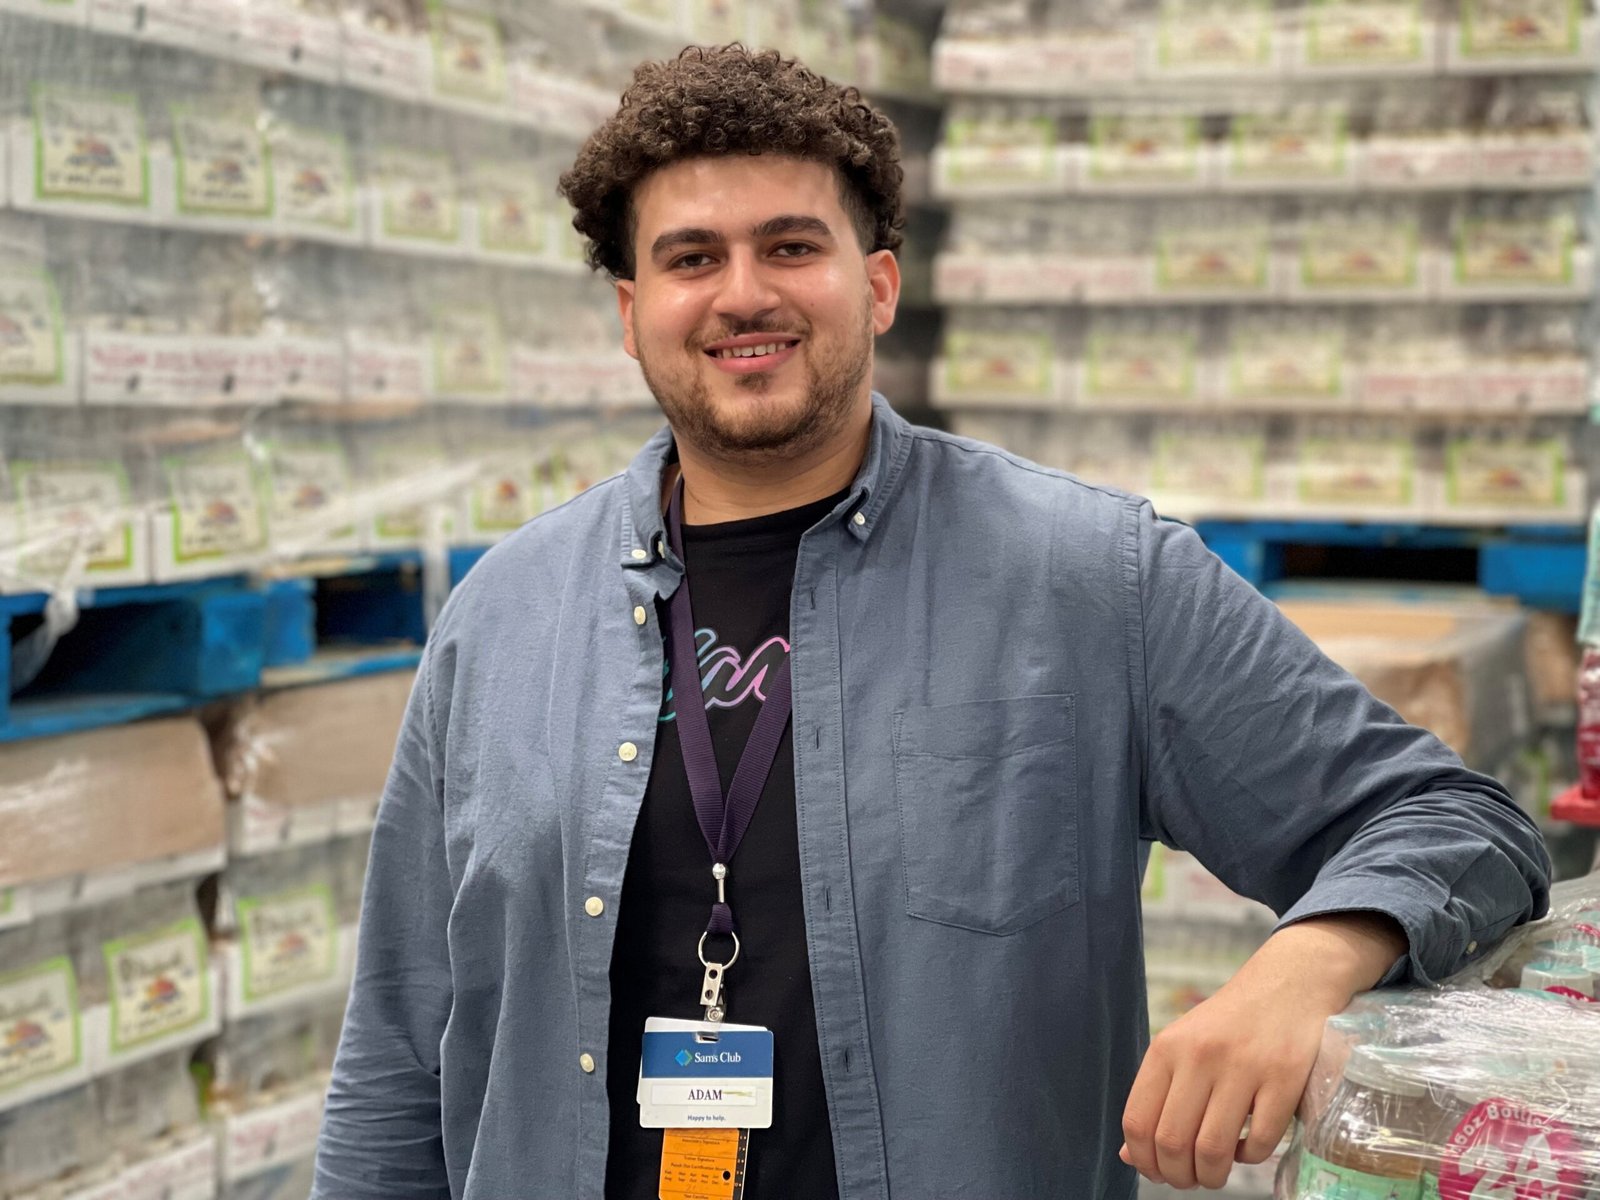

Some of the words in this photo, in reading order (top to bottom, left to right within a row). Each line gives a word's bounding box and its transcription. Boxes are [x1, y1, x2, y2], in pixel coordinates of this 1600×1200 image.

[694, 1052, 718, 1063] Sam's
[719, 1052, 741, 1063] Club
[687, 1089, 723, 1101] ADAM
[687, 1114, 705, 1123] Happy
[713, 1114, 726, 1123] help.
